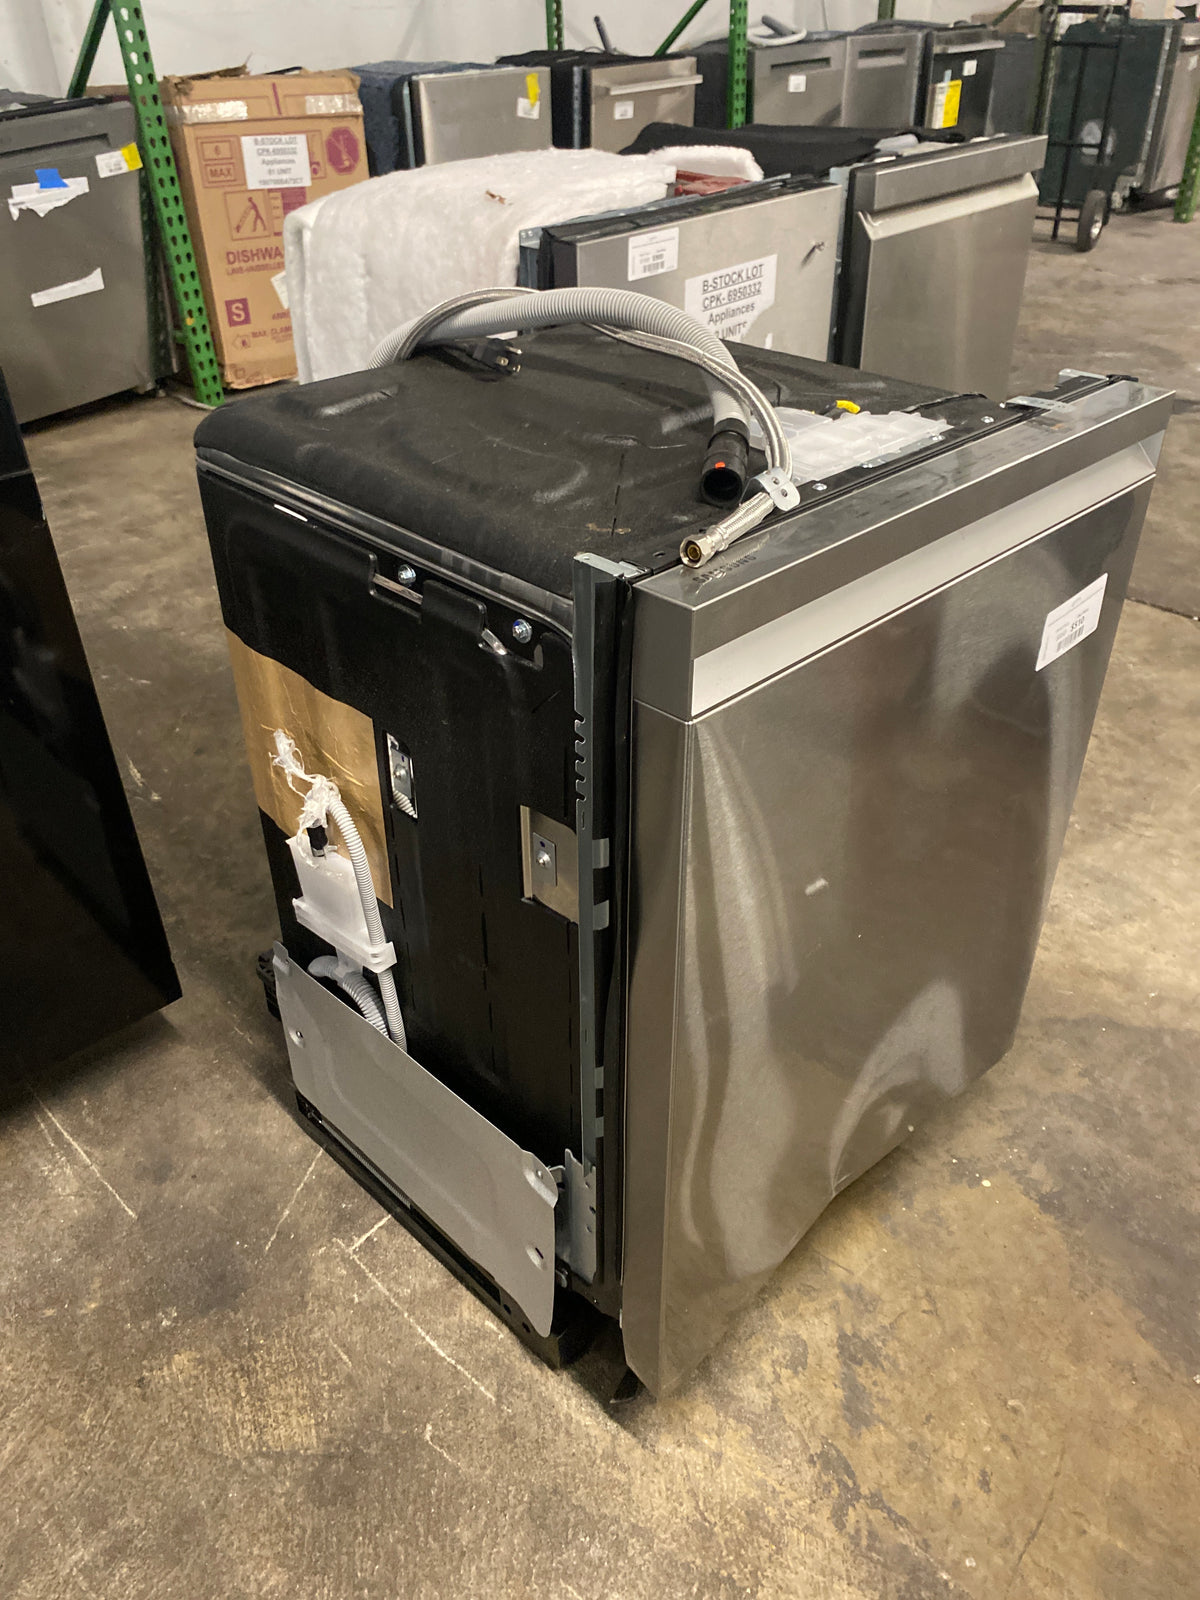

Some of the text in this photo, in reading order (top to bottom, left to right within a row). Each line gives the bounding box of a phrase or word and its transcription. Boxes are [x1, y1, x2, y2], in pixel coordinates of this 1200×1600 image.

[209, 168, 232, 178] MAX
[703, 264, 764, 292] B-STOCK LOT
[703, 293, 725, 309] CPK-
[231, 302, 246, 321] S
[708, 302, 755, 326] Appliances
